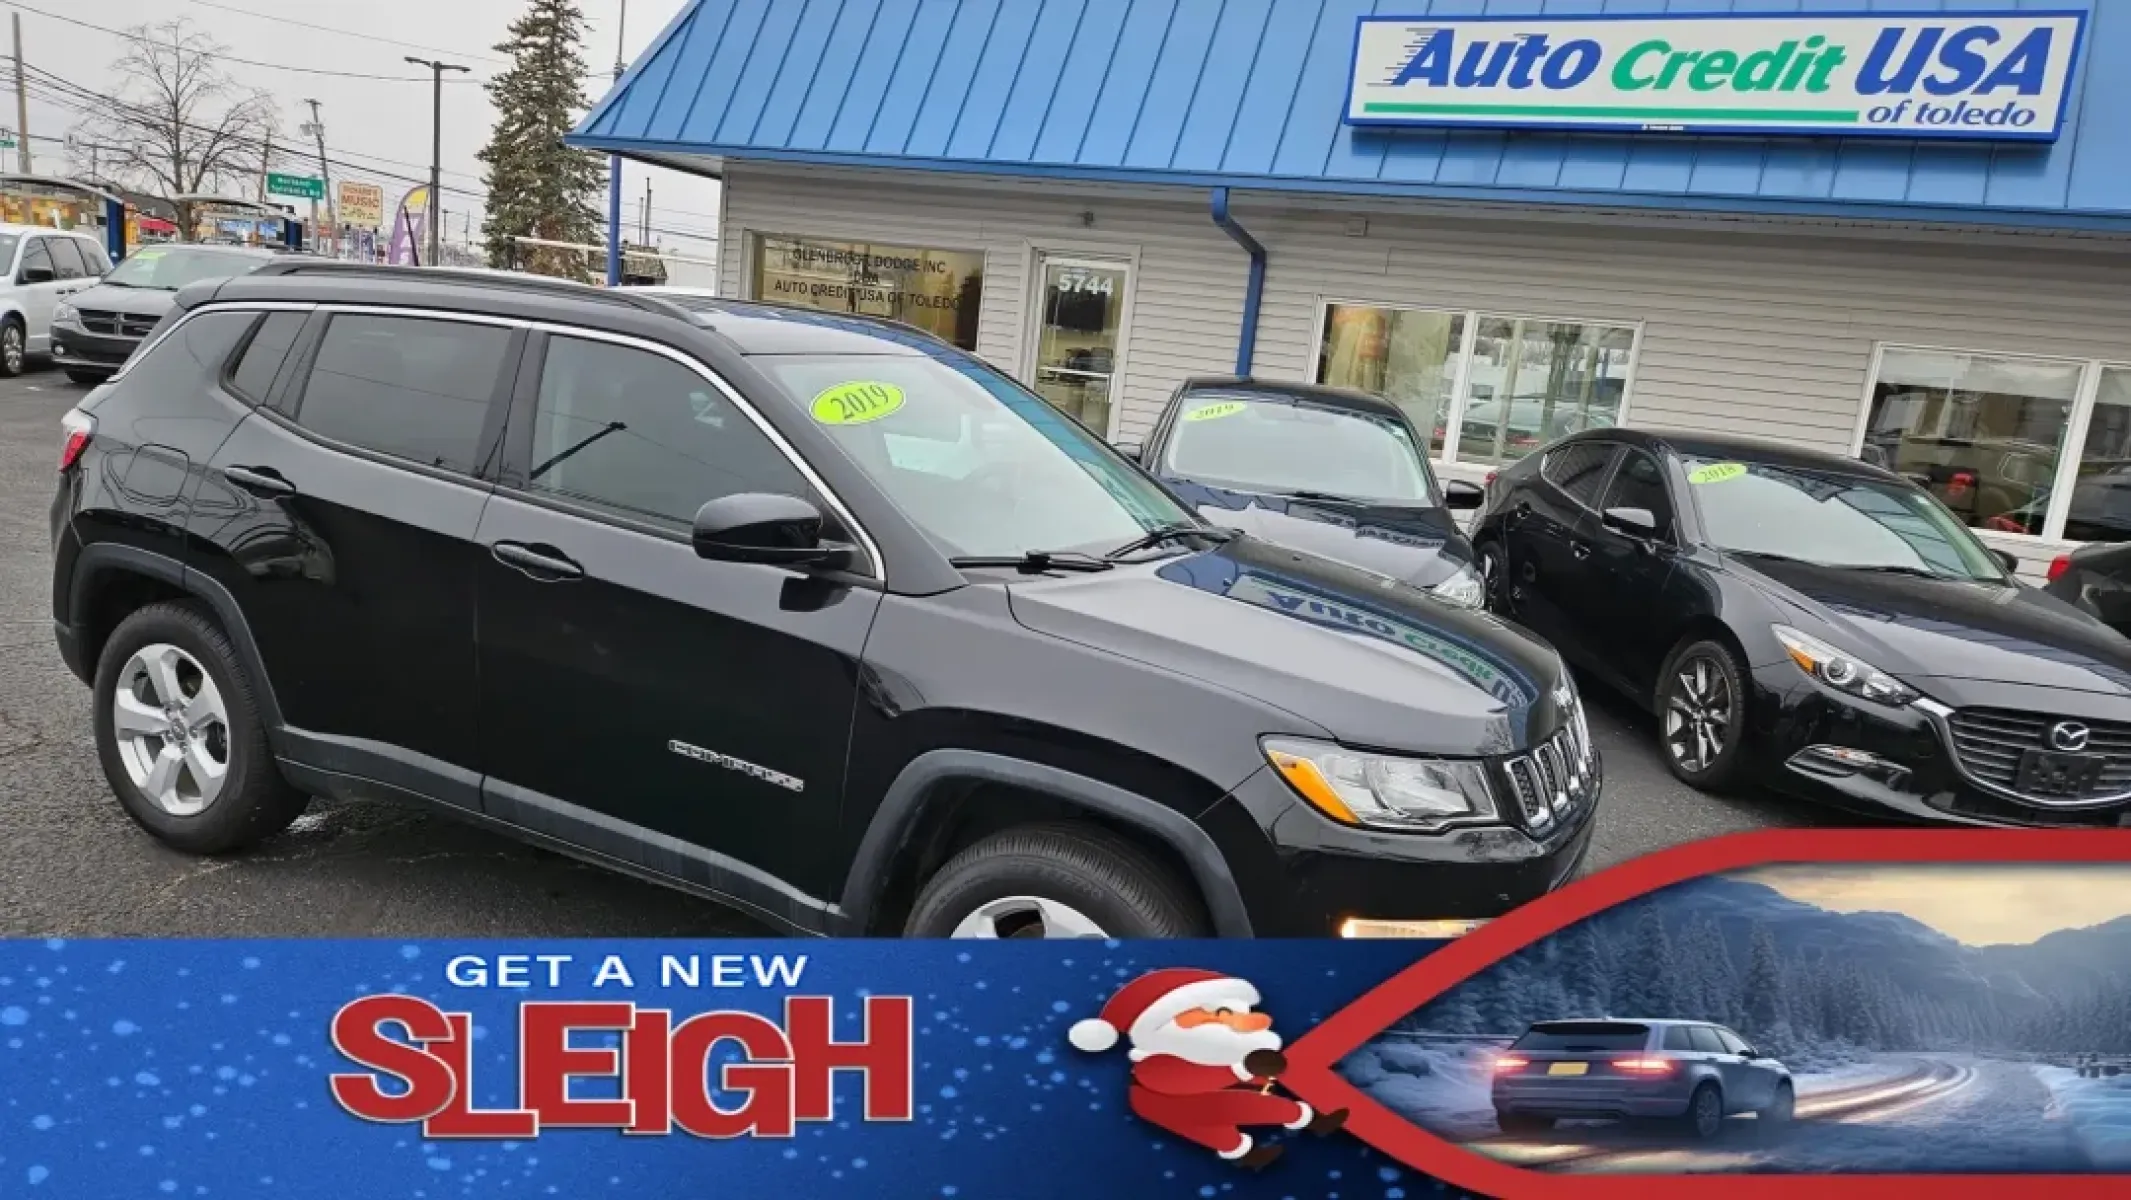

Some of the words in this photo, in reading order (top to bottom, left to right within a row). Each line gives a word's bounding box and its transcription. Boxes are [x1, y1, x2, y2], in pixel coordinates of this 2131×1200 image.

[1388, 28, 1602, 90] Auto
[1611, 35, 1847, 93] Credit
[1854, 25, 2054, 96] USA
[1867, 100, 1912, 124] of
[1914, 102, 2036, 127] toledo
[341, 194, 380, 208] MUSIC
[922, 260, 947, 273] INC
[774, 280, 808, 295] AUTO
[858, 288, 884, 303] USA
[1059, 273, 1114, 297] 5744
[830, 384, 889, 421] 2019
